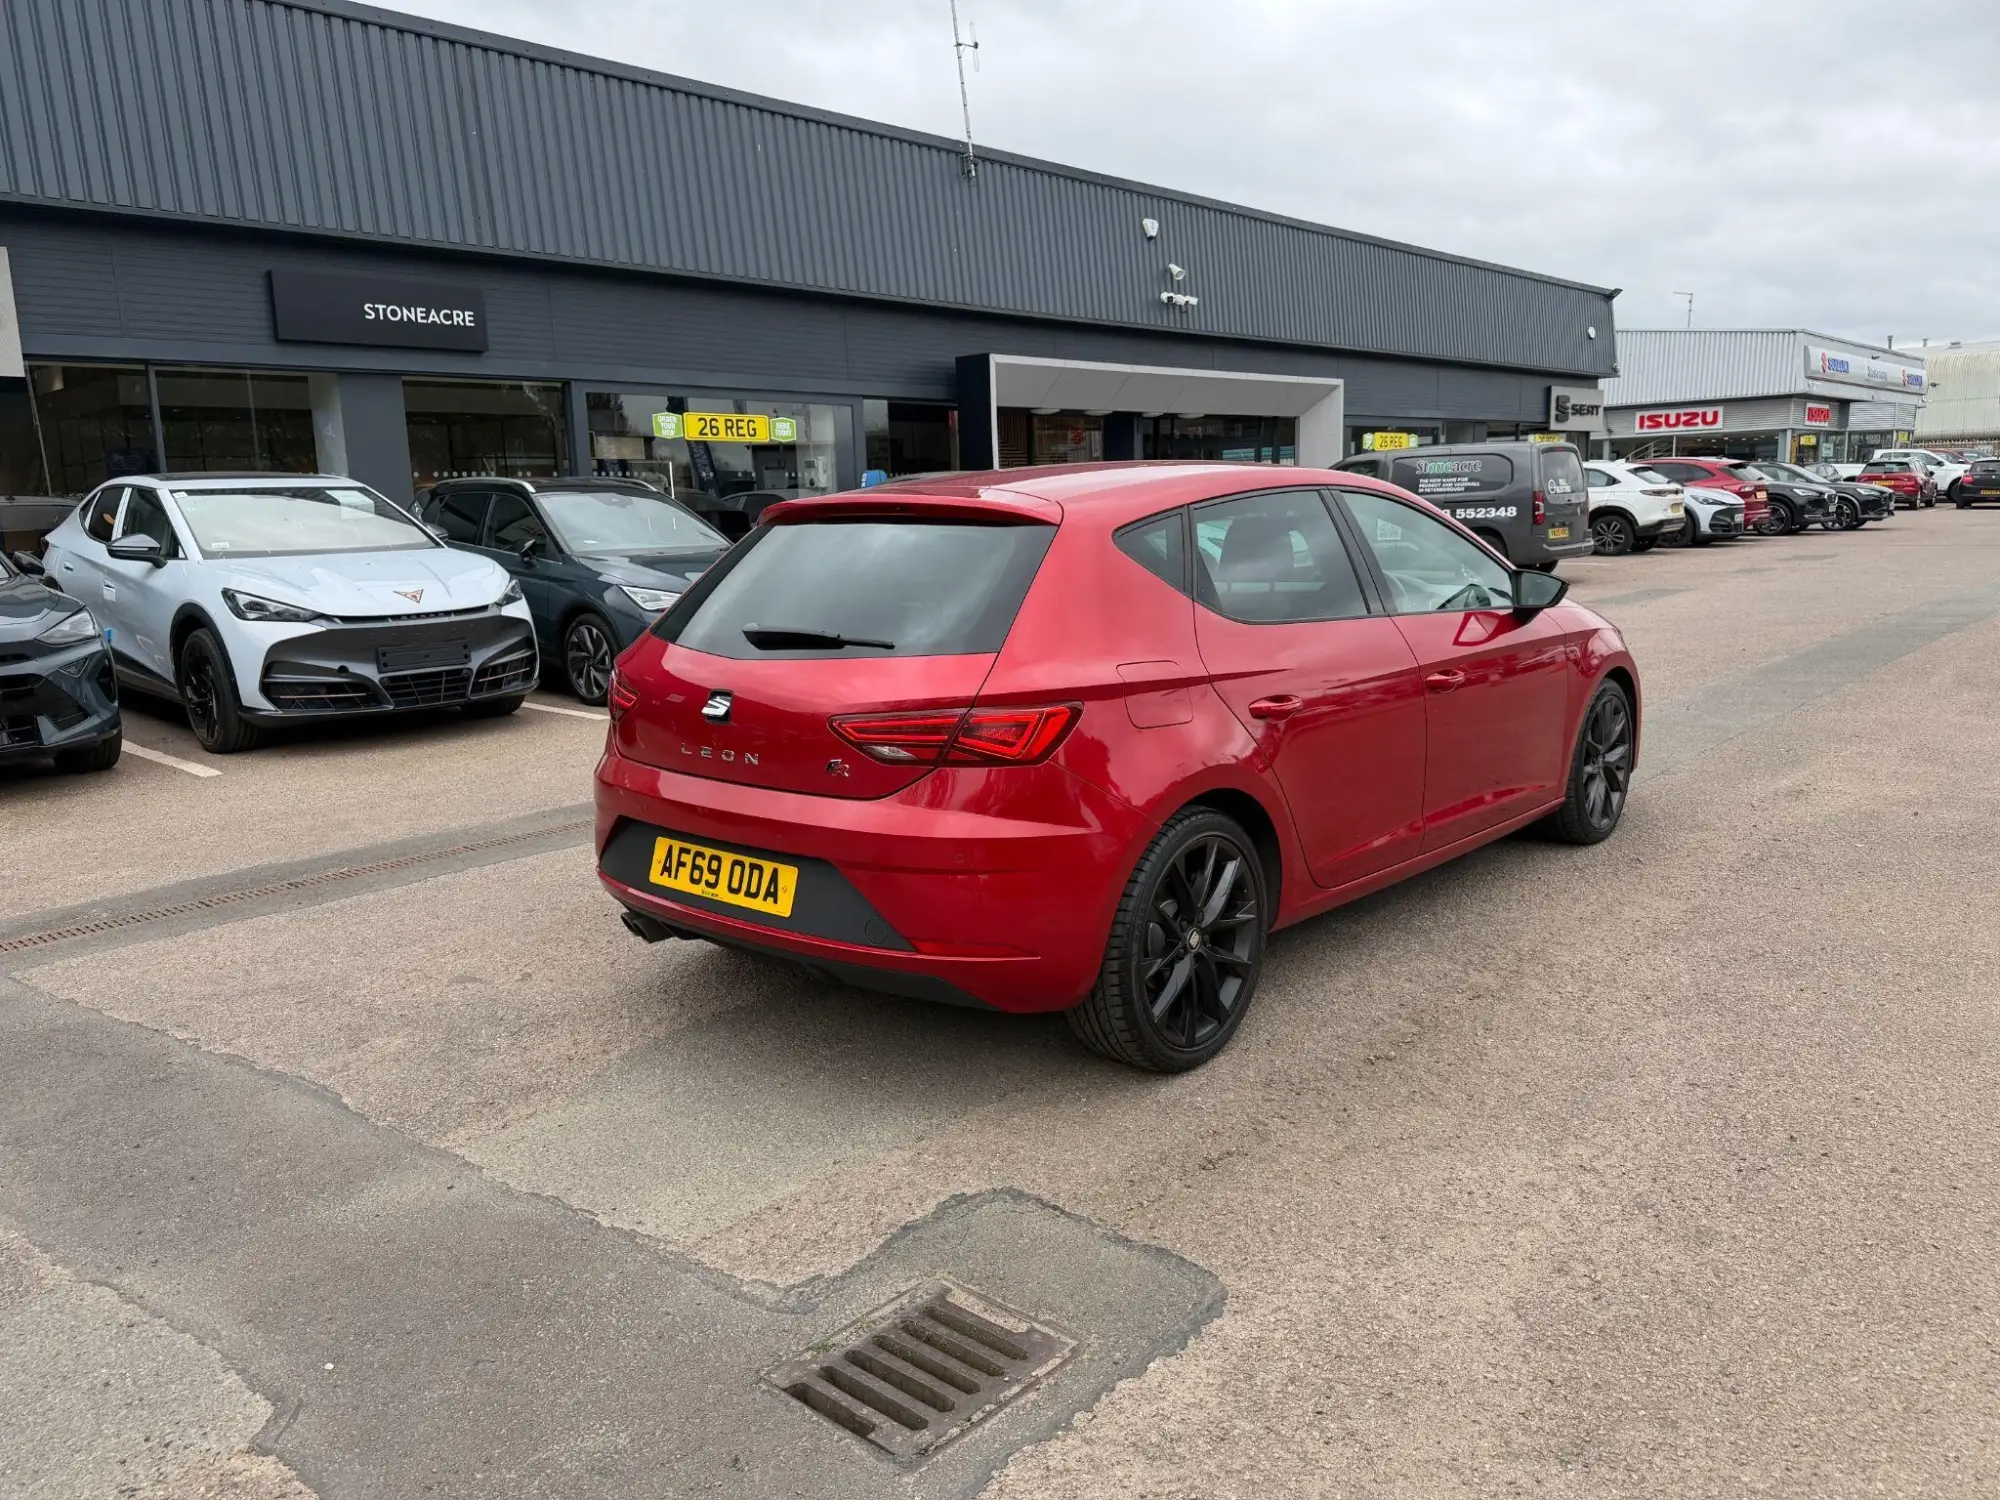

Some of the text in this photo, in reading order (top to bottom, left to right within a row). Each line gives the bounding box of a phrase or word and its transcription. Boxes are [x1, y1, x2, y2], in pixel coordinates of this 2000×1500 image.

[363, 303, 475, 327] STONEACRE
[1571, 404, 1601, 416] SEAT
[1807, 406, 1831, 422] ISUZU
[697, 417, 757, 438] 26 REG
[1638, 410, 1719, 430] ISUZU
[1379, 435, 1389, 448] 26
[1389, 435, 1403, 448] REG
[1416, 459, 1482, 475] Stoneacre
[1455, 506, 1518, 519] 552348
[681, 742, 759, 766] LEON
[660, 844, 779, 905] AF69 ODA
